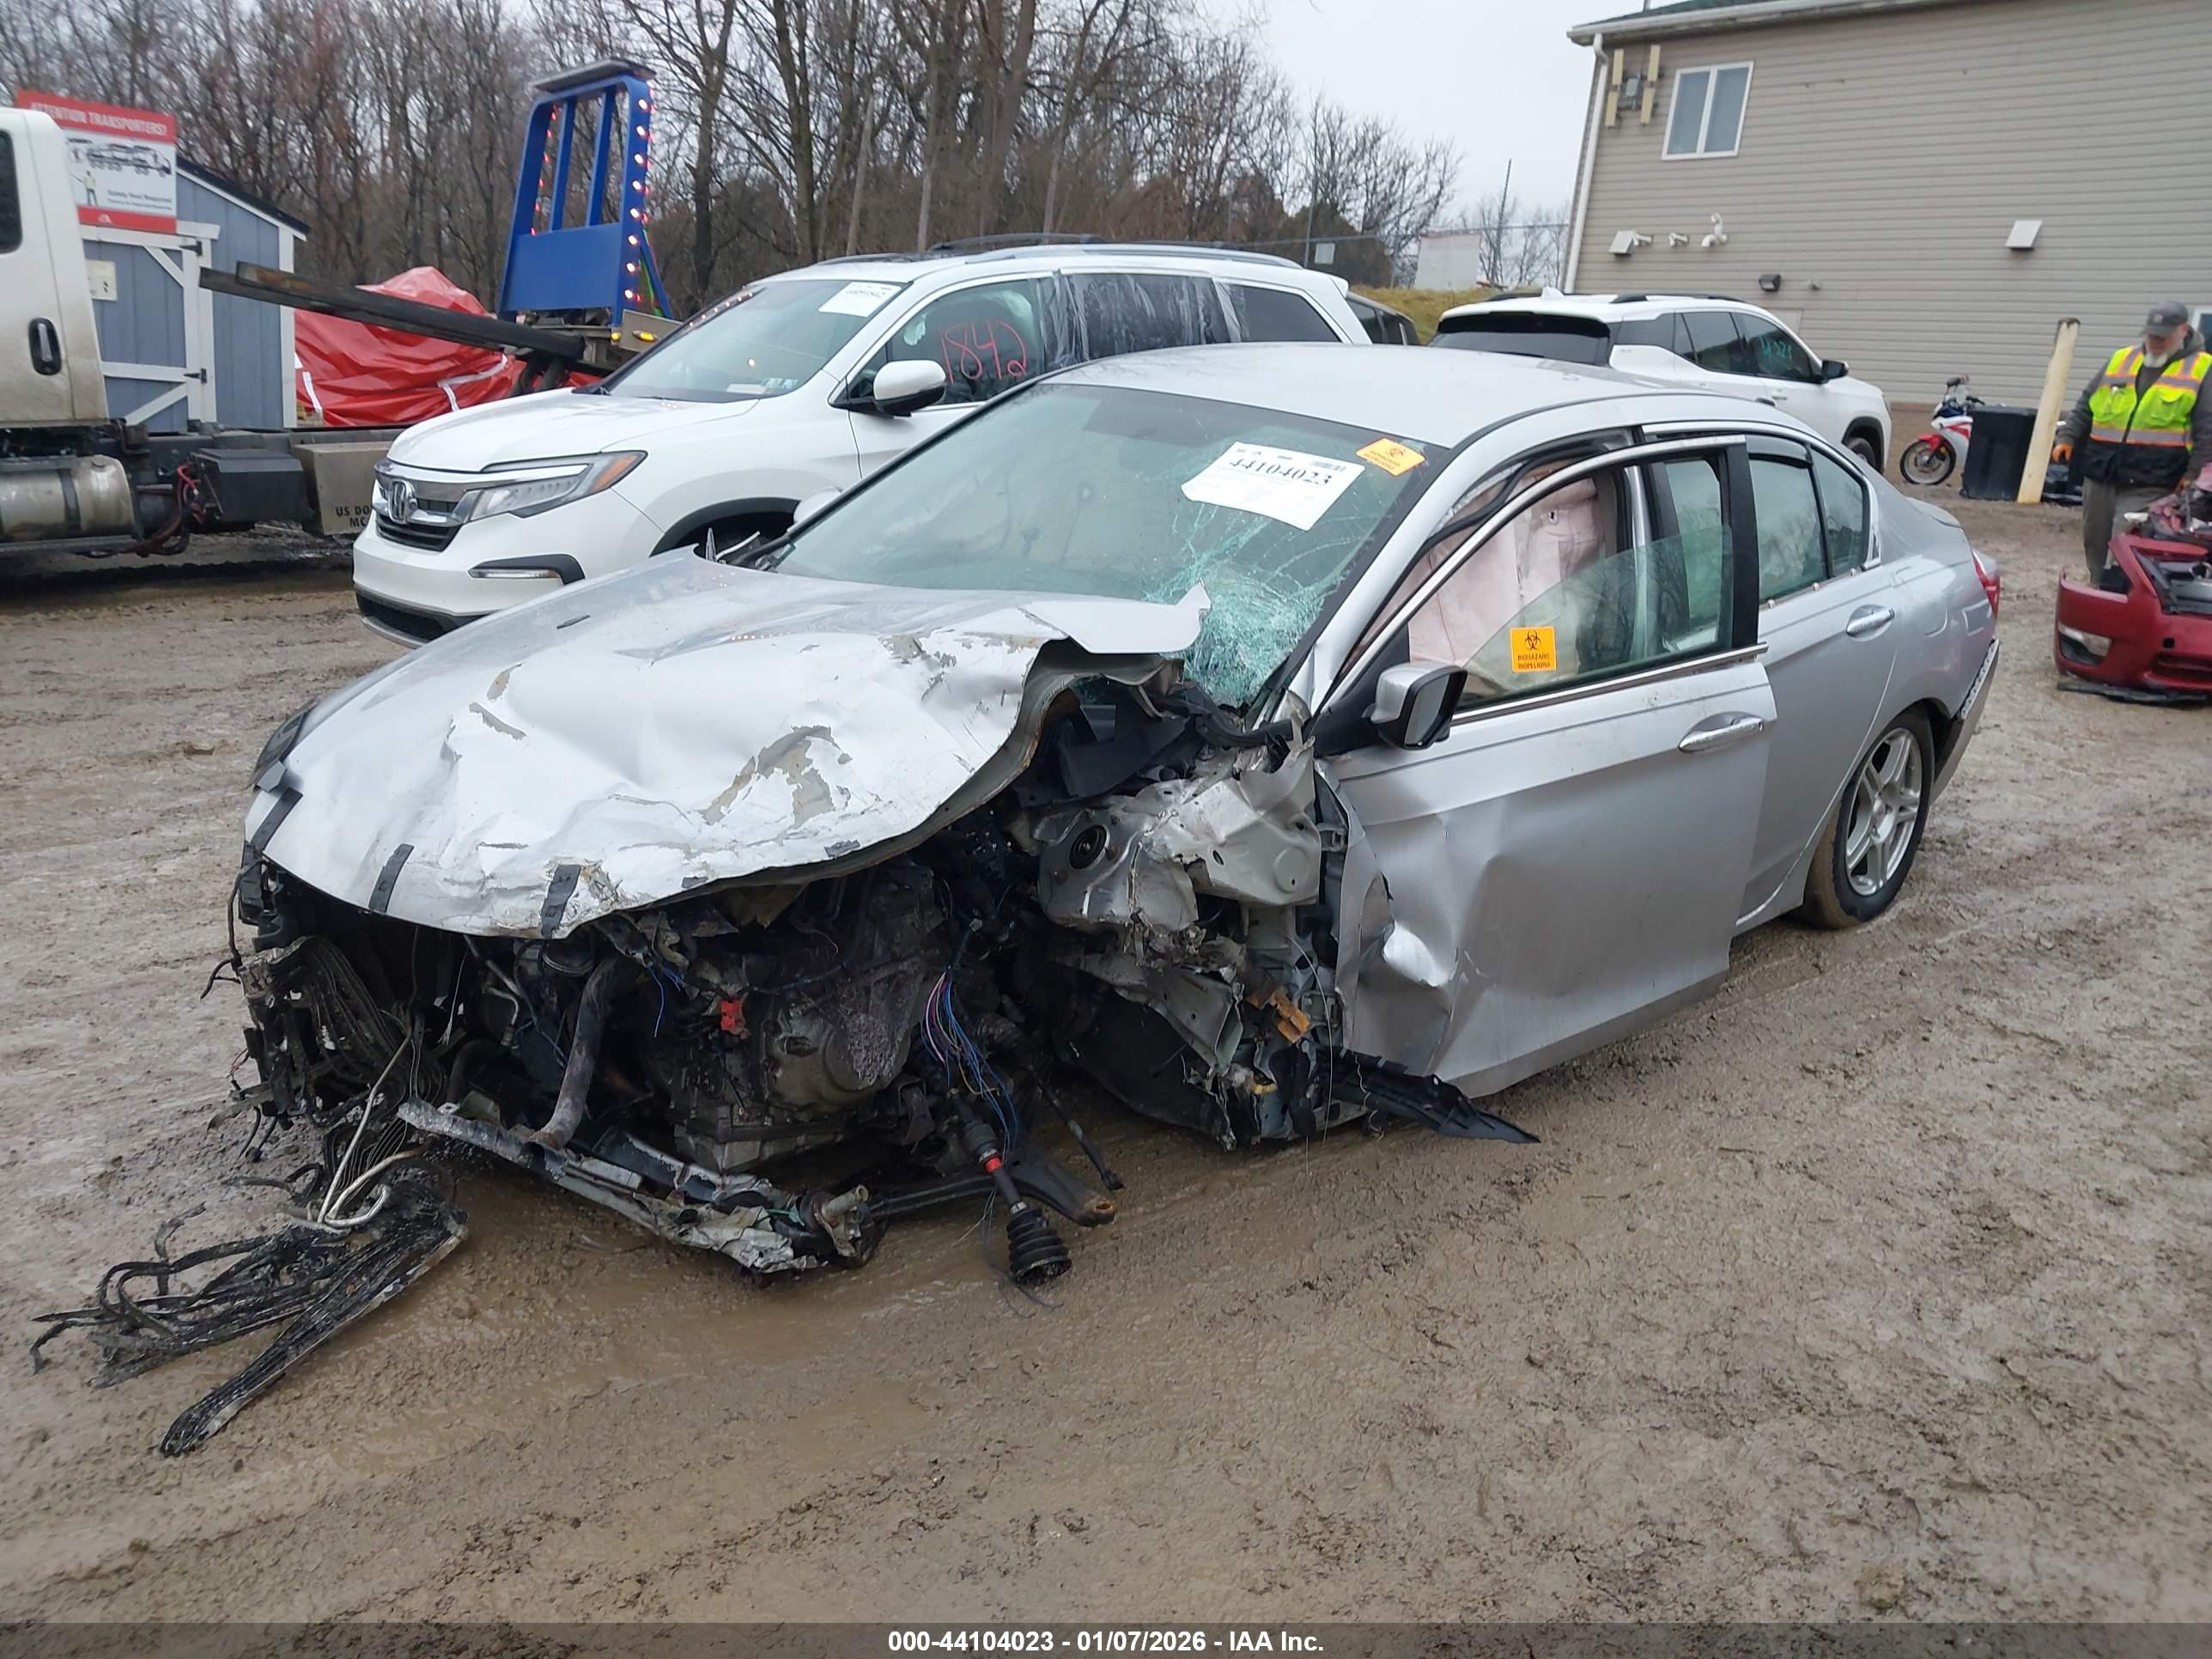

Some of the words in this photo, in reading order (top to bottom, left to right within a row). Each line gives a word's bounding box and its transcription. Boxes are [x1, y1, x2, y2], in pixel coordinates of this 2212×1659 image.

[939, 319, 1027, 385] 1842
[1230, 458, 1333, 486] 44104023
[336, 507, 350, 517] US
[355, 505, 371, 515] DO
